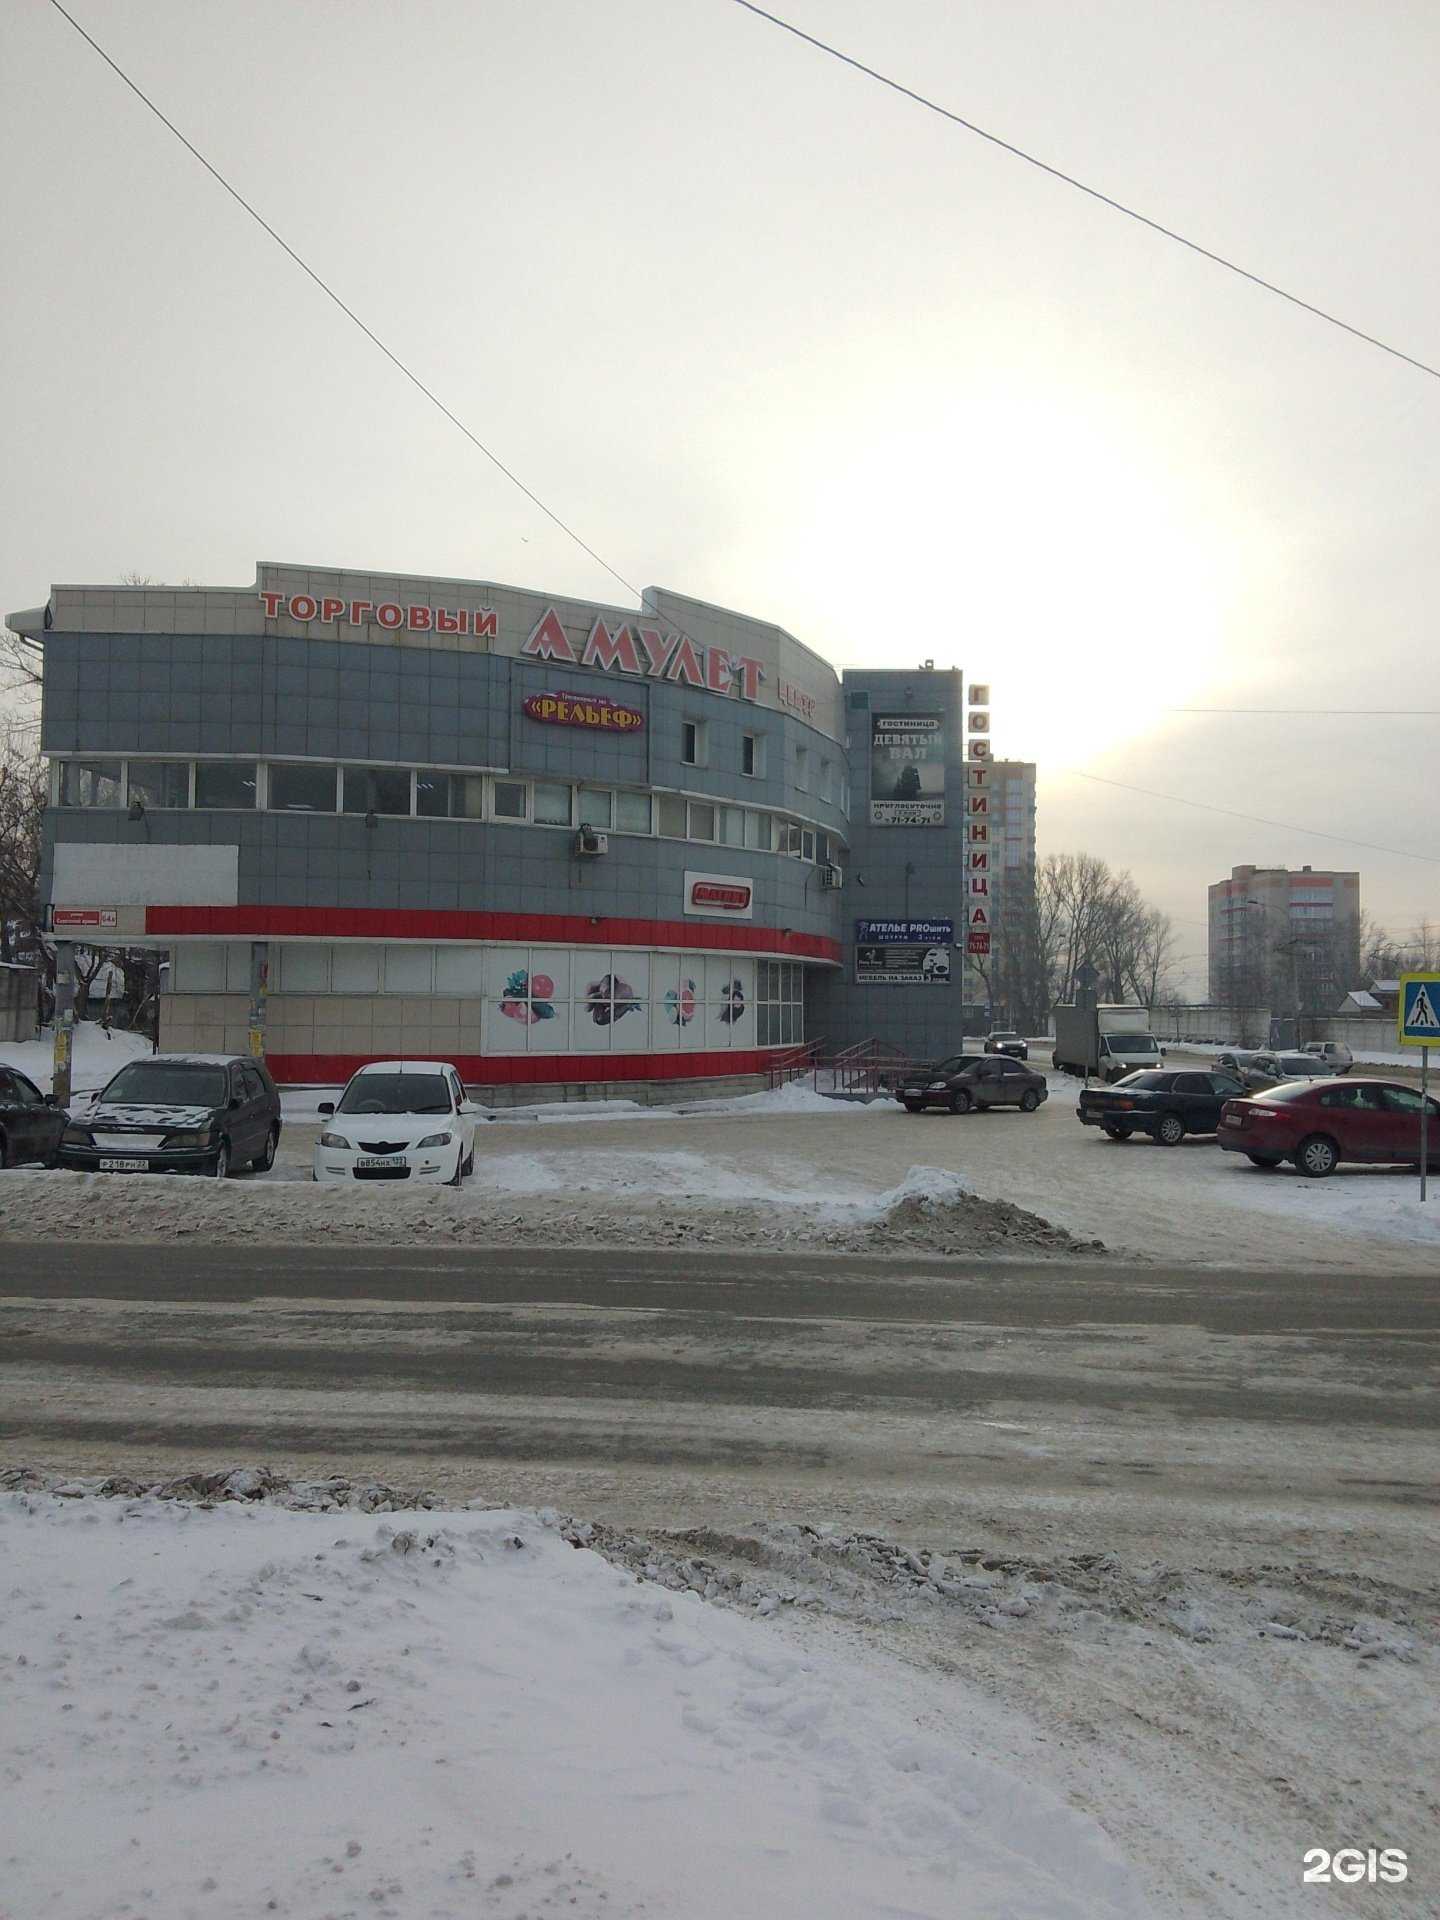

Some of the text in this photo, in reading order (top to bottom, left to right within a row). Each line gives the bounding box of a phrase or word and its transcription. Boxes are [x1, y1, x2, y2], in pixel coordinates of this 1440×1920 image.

[259, 591, 498, 637] ТОРГОВЫЙ
[521, 607, 767, 704] АМУЛЕТ
[873, 733, 943, 747] ДЕВЯТЫЙ
[889, 747, 928, 760] ВАЛ
[972, 688, 988, 923] ГОСТИНИЦА
[869, 923, 907, 933] АТЕЛЬЕ
